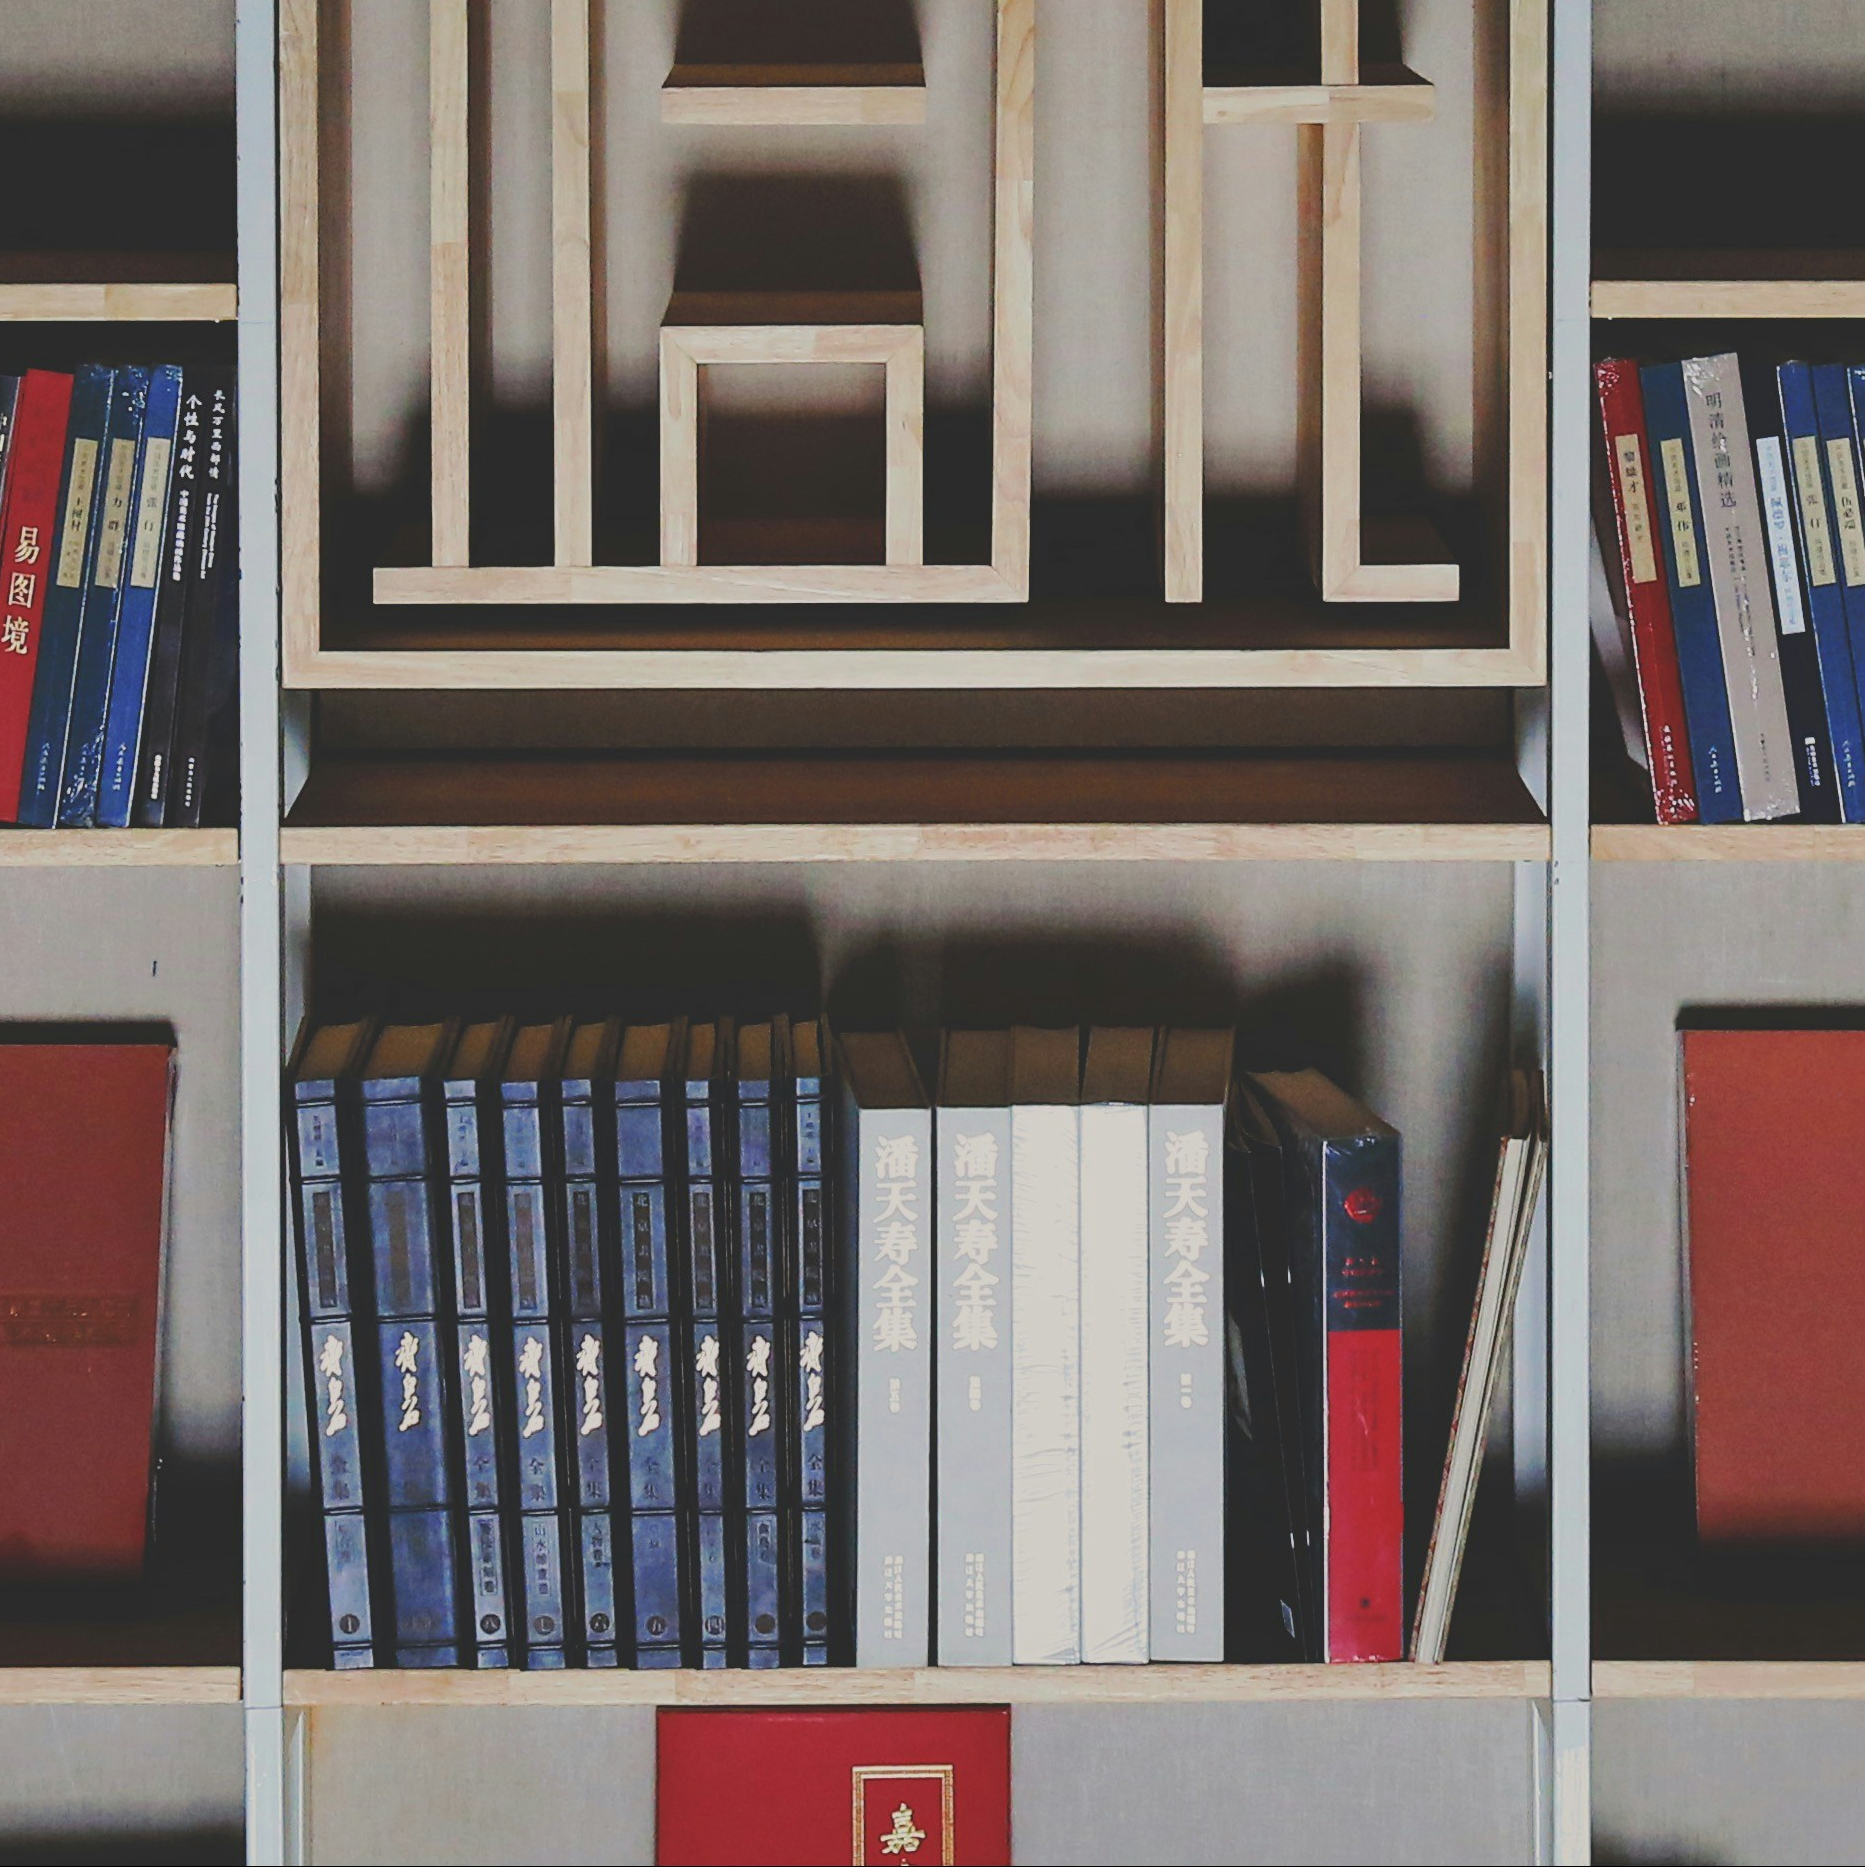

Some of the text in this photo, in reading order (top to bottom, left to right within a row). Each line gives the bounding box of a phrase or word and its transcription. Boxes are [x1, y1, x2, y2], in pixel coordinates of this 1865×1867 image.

[178, 394, 203, 480] 个性与时代
[0, 526, 41, 655] 易图境
[872, 1135, 919, 1354] 潘天寿全集
[951, 1132, 999, 1352] 潘天寿全集
[1162, 1130, 1210, 1349] 潘天寿全集
[878, 1802, 926, 1857] 嘉
